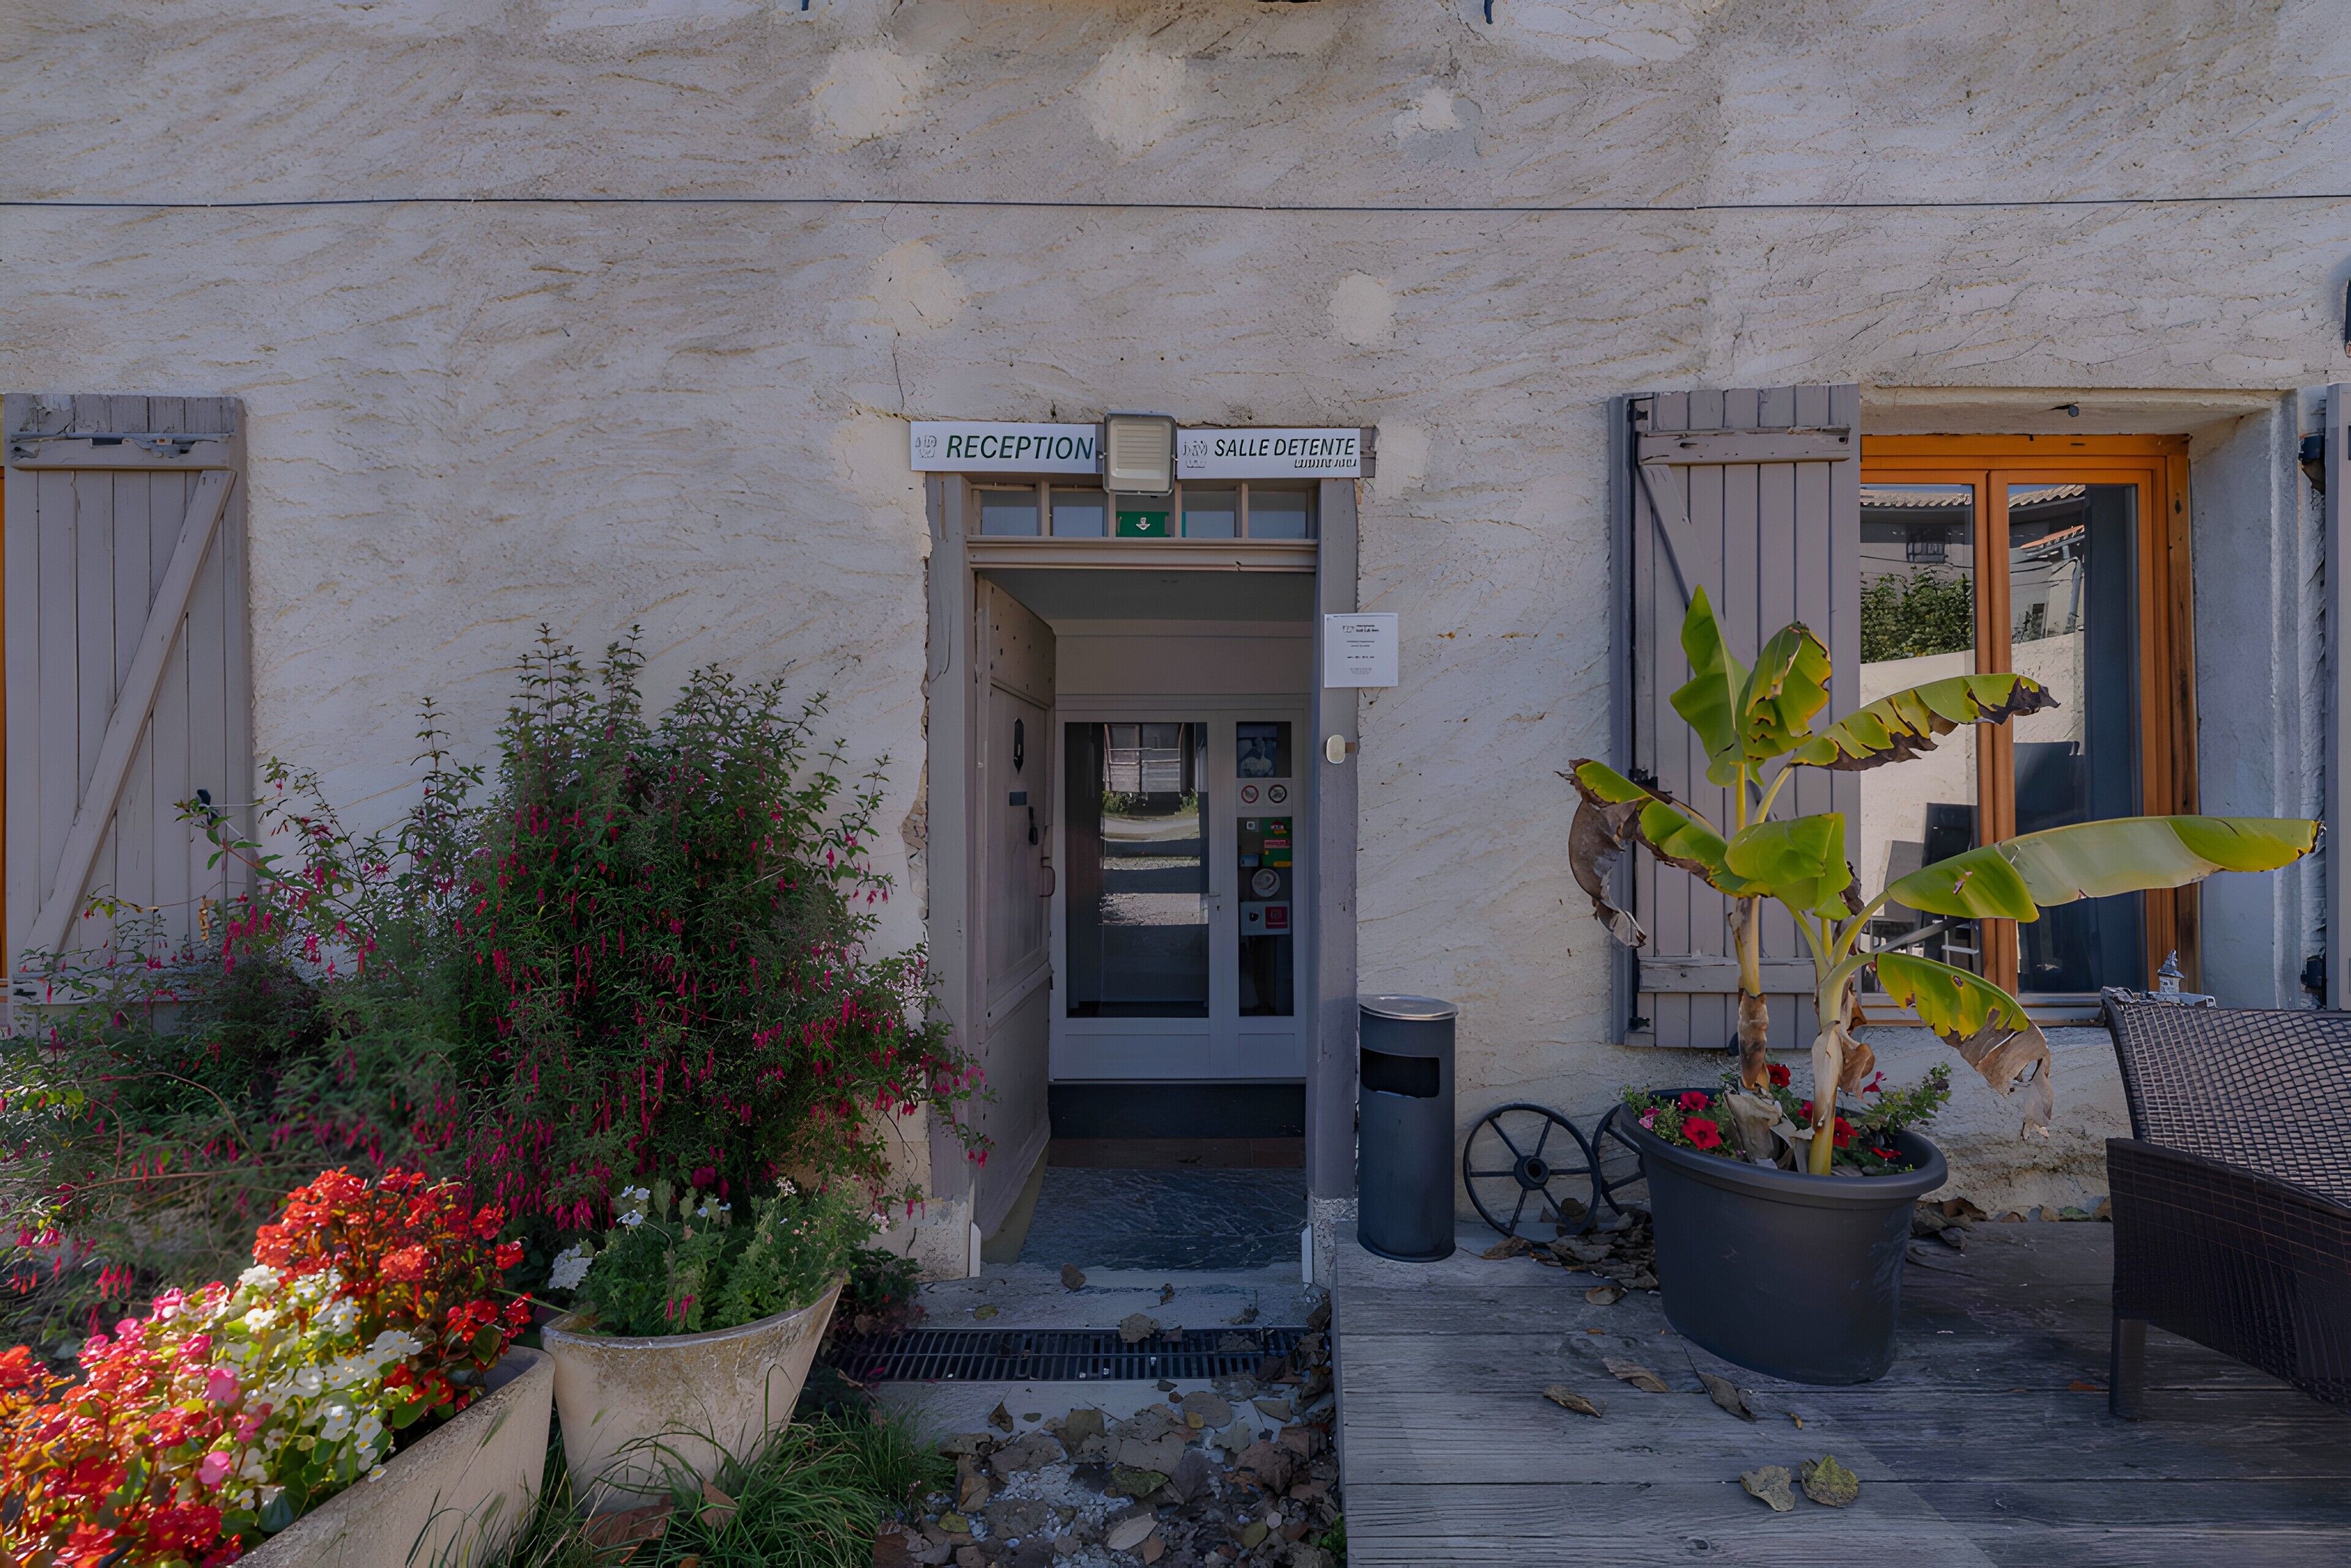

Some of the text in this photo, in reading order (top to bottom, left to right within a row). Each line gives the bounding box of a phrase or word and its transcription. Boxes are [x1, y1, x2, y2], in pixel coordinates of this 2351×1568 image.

[947, 435, 1093, 459] RECEPTION
[1214, 438, 1355, 457] SALLE DETENTE
